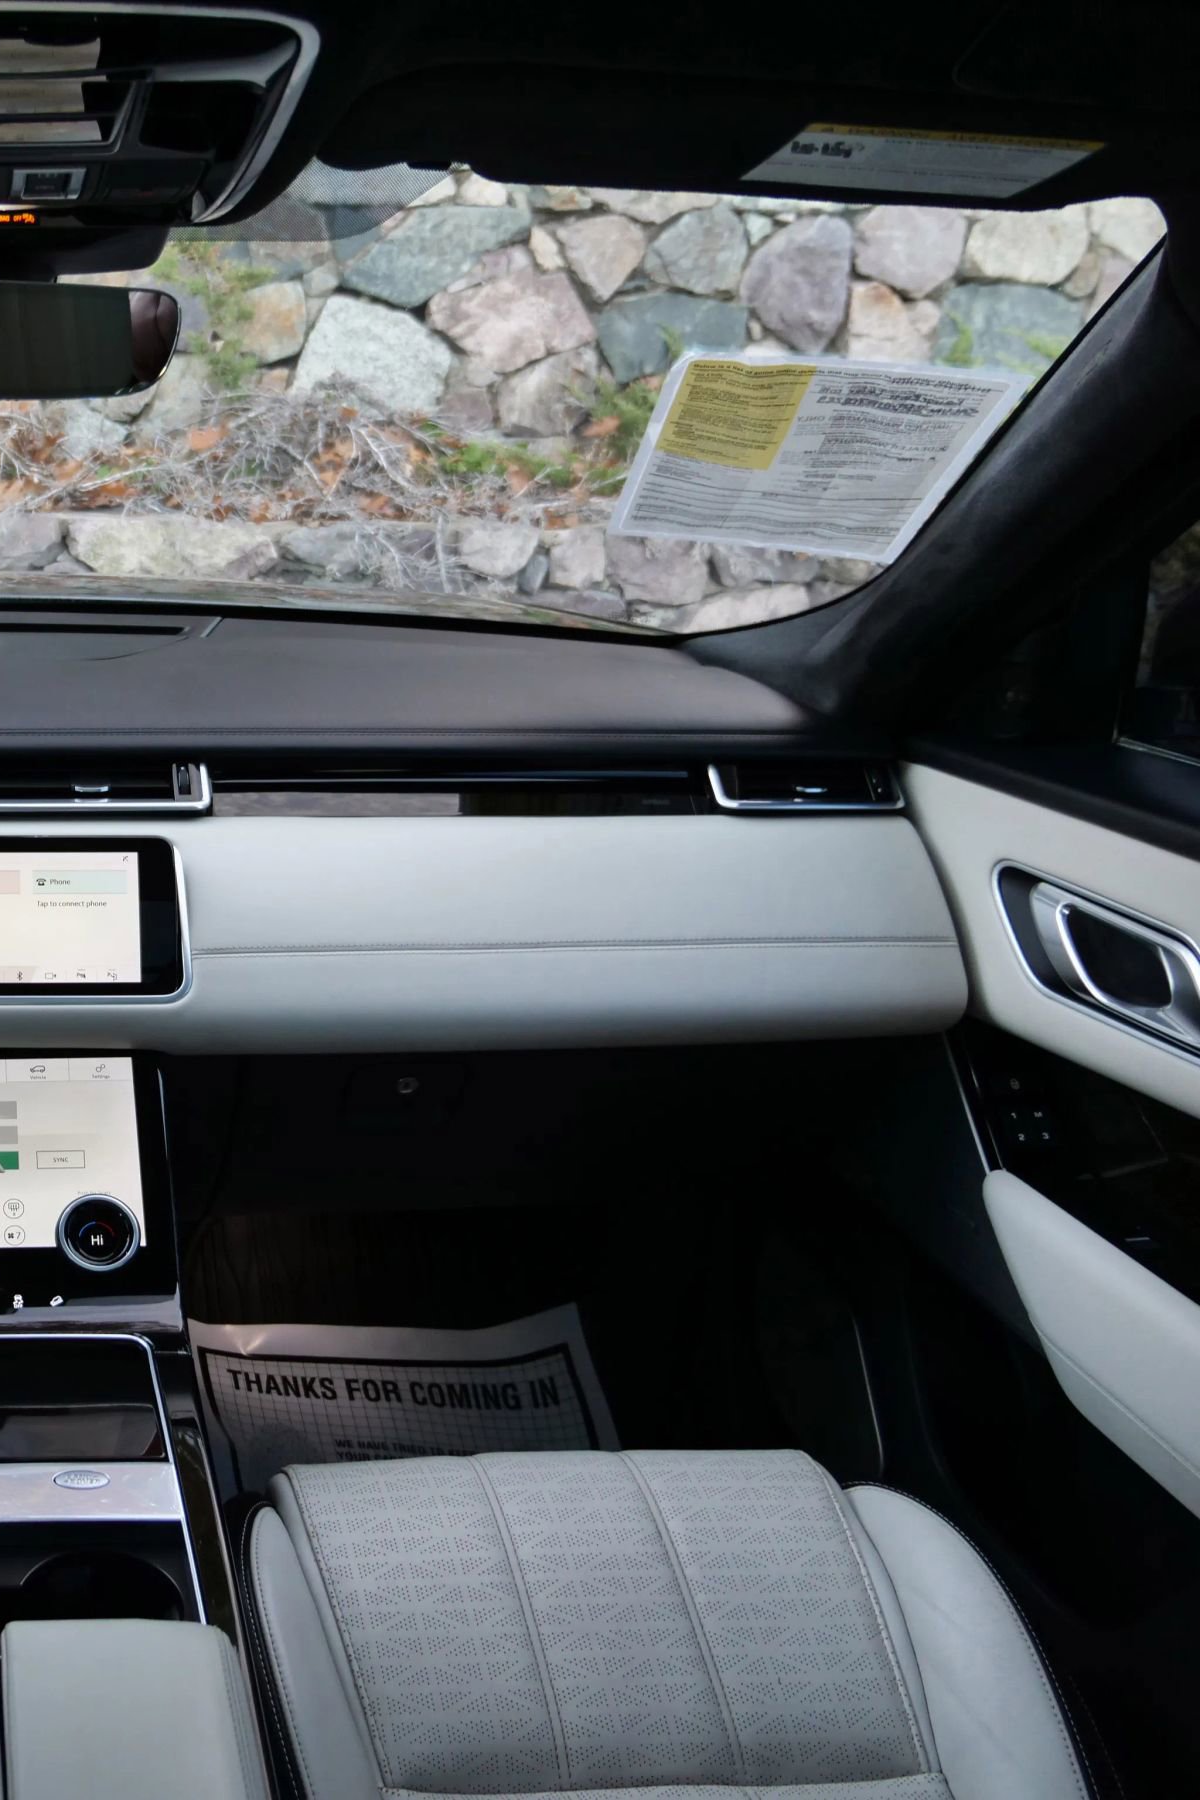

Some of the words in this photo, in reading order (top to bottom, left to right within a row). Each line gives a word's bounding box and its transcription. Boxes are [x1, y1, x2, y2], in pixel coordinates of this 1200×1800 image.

[86, 901, 107, 909] phone
[91, 1234, 103, 1246] Hi
[226, 1368, 338, 1400] THANKS
[346, 1378, 402, 1403] FOR
[410, 1382, 522, 1410] COMING
[530, 1376, 560, 1408] IN
[336, 1440, 354, 1448] WE
[357, 1441, 388, 1450] HAVE
[392, 1442, 426, 1454] TRIED
